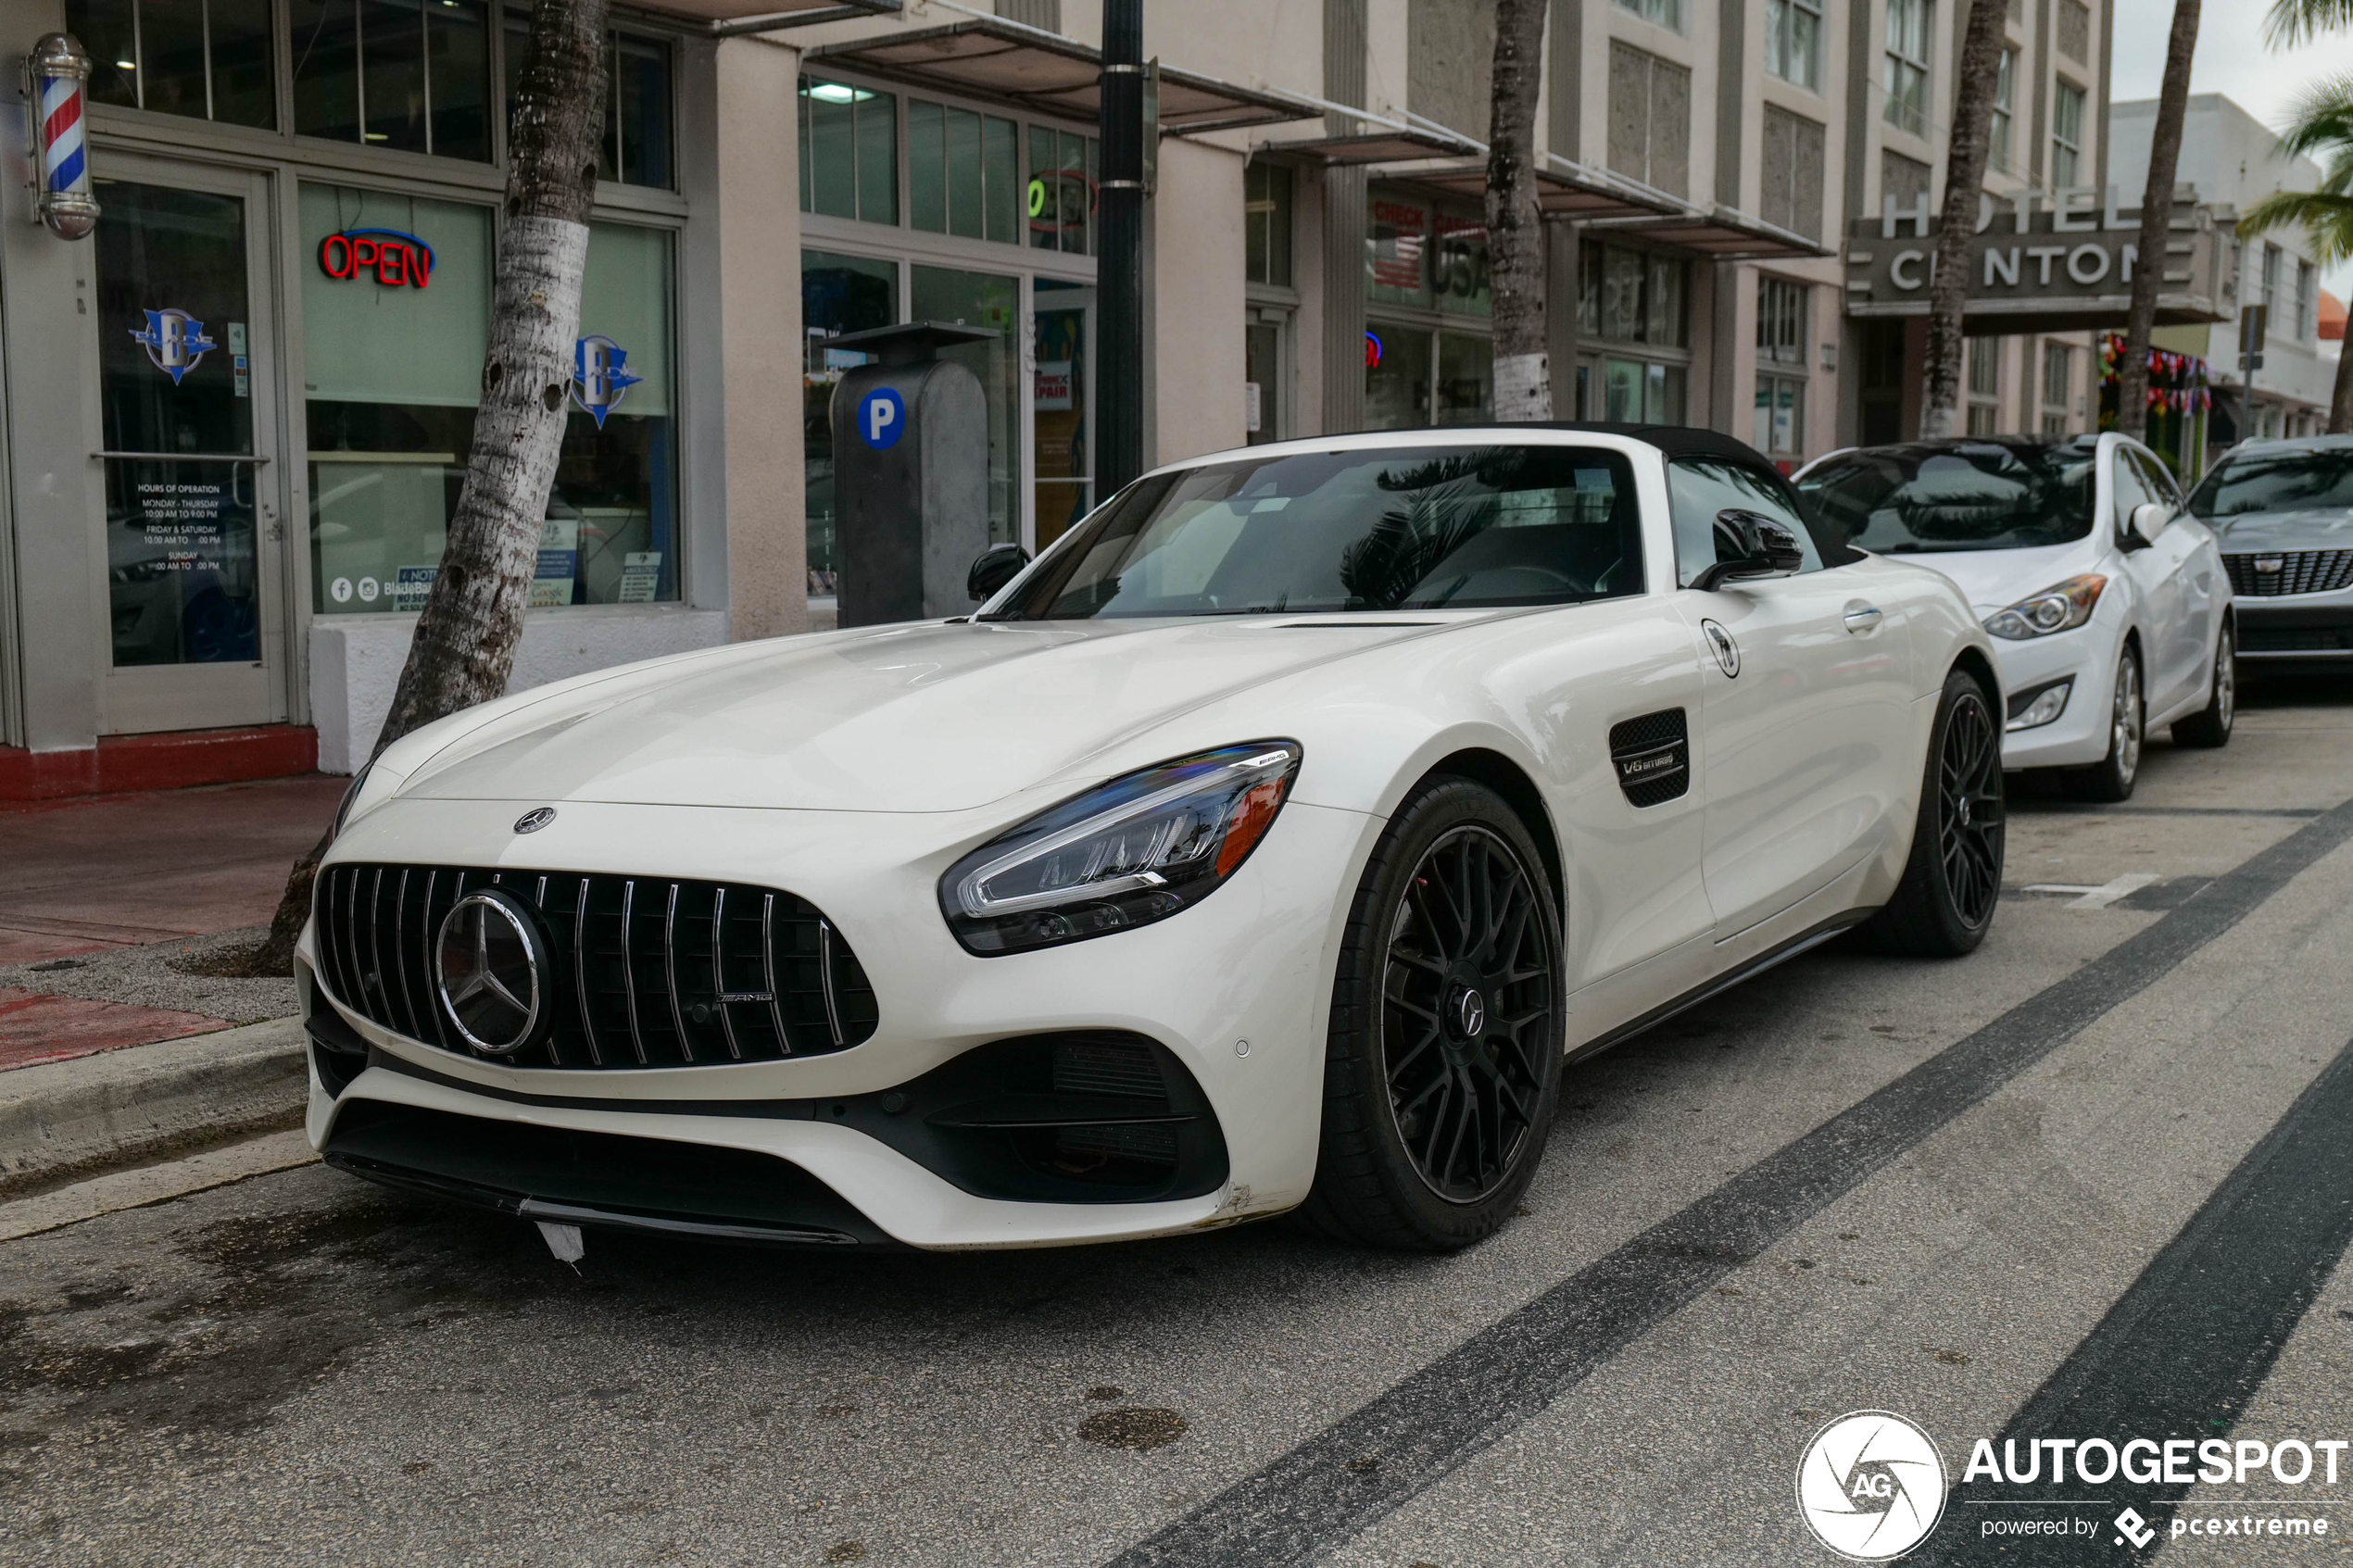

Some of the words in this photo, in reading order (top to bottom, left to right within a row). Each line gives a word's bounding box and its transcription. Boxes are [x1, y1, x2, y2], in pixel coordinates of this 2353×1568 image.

[1375, 200, 1424, 228] CHECK
[323, 234, 429, 288] OPEN
[871, 398, 895, 440] P
[137, 483, 165, 494] HOURS
[166, 484, 177, 494] OF
[178, 484, 220, 495] OPERATION
[142, 499, 176, 508] MONDAY
[182, 500, 220, 509] THURSDAY
[145, 509, 164, 519] 10:00
[165, 509, 178, 519] AM
[179, 509, 190, 519] TO
[191, 509, 206, 519] 9:00
[207, 509, 218, 519] PM
[146, 525, 172, 534] FRIDAY
[174, 525, 179, 534] &
[181, 525, 218, 534] SATURDAY
[164, 535, 177, 545] AM
[178, 535, 189, 545] TO
[209, 535, 220, 545] PM
[168, 551, 198, 560] SUNDAY
[167, 561, 180, 571] AM
[181, 561, 192, 571] TO
[208, 560, 220, 570] PM
[1642, 755, 1674, 770] BITURBO
